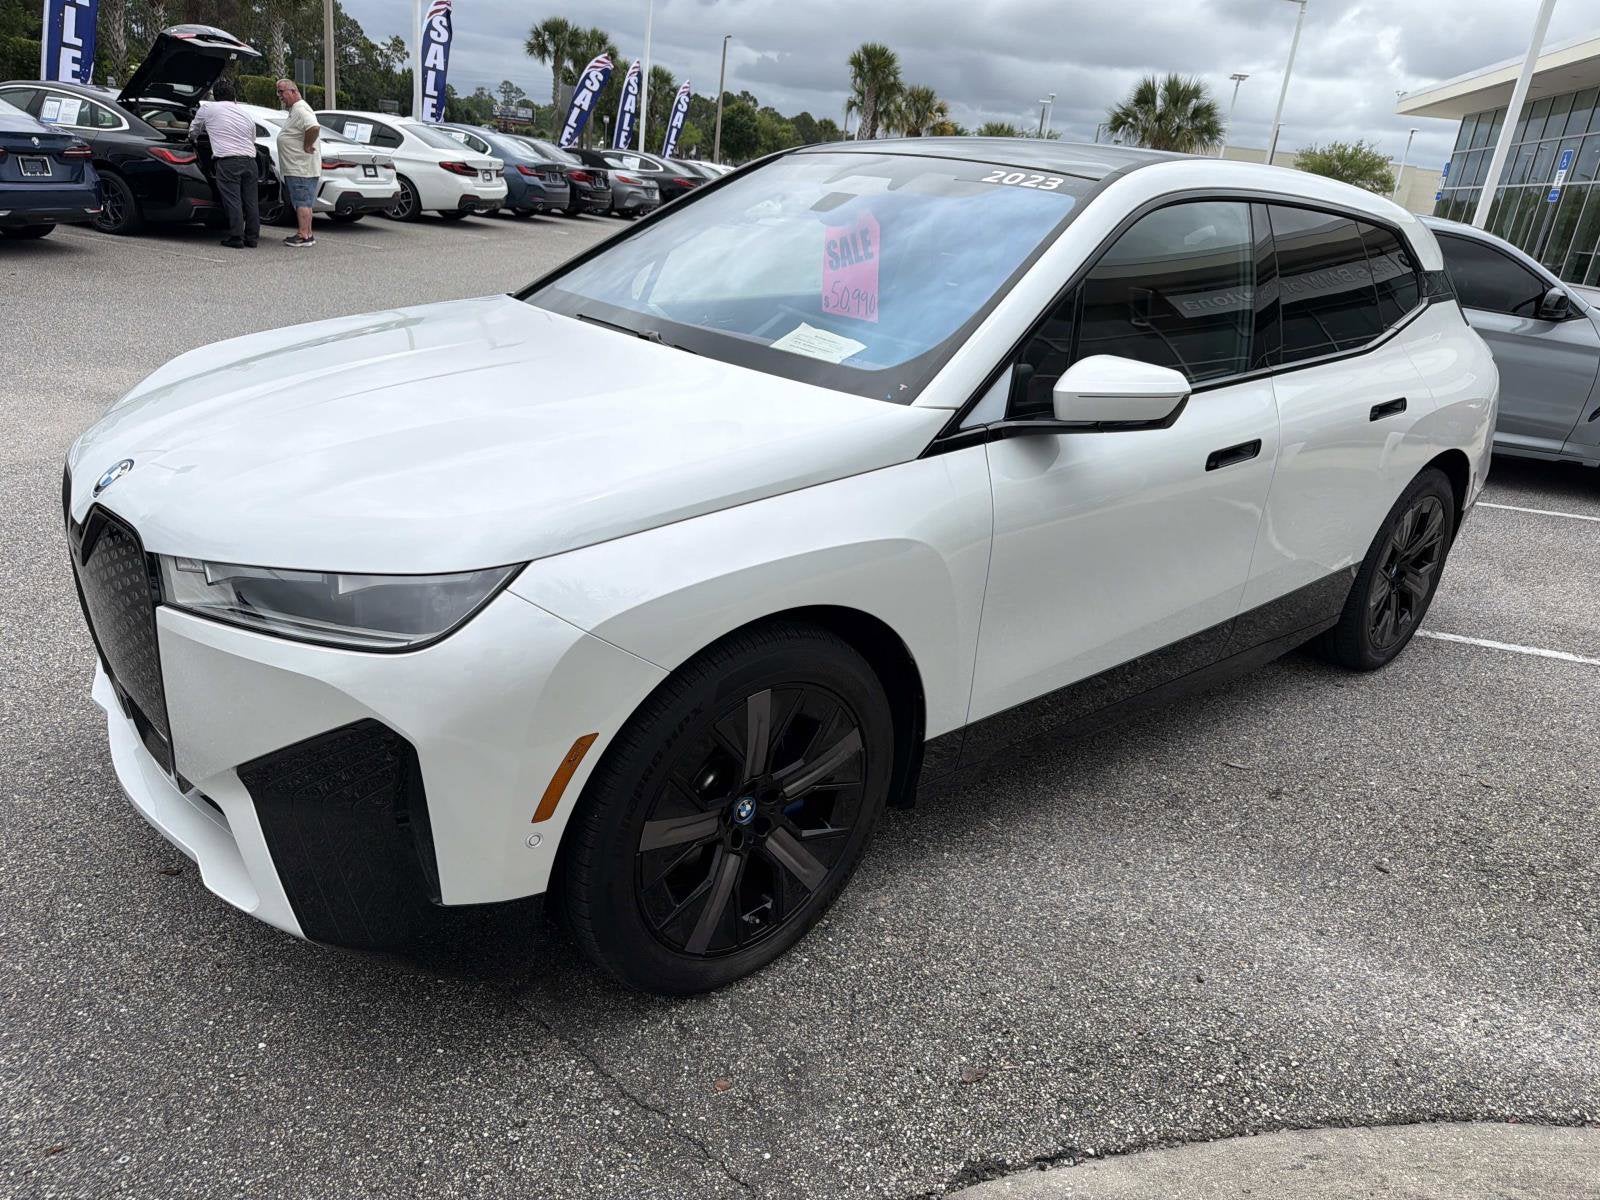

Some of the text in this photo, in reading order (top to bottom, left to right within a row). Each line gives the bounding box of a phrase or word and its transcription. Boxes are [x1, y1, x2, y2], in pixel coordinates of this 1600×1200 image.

[59, 0, 90, 84] LE
[422, 15, 449, 122] SALE
[560, 70, 604, 146] SALE
[619, 76, 639, 149] SALE
[665, 95, 690, 159] SALE
[981, 170, 1064, 190] 2023
[826, 227, 874, 271] SALE
[823, 281, 878, 315] $50,990
